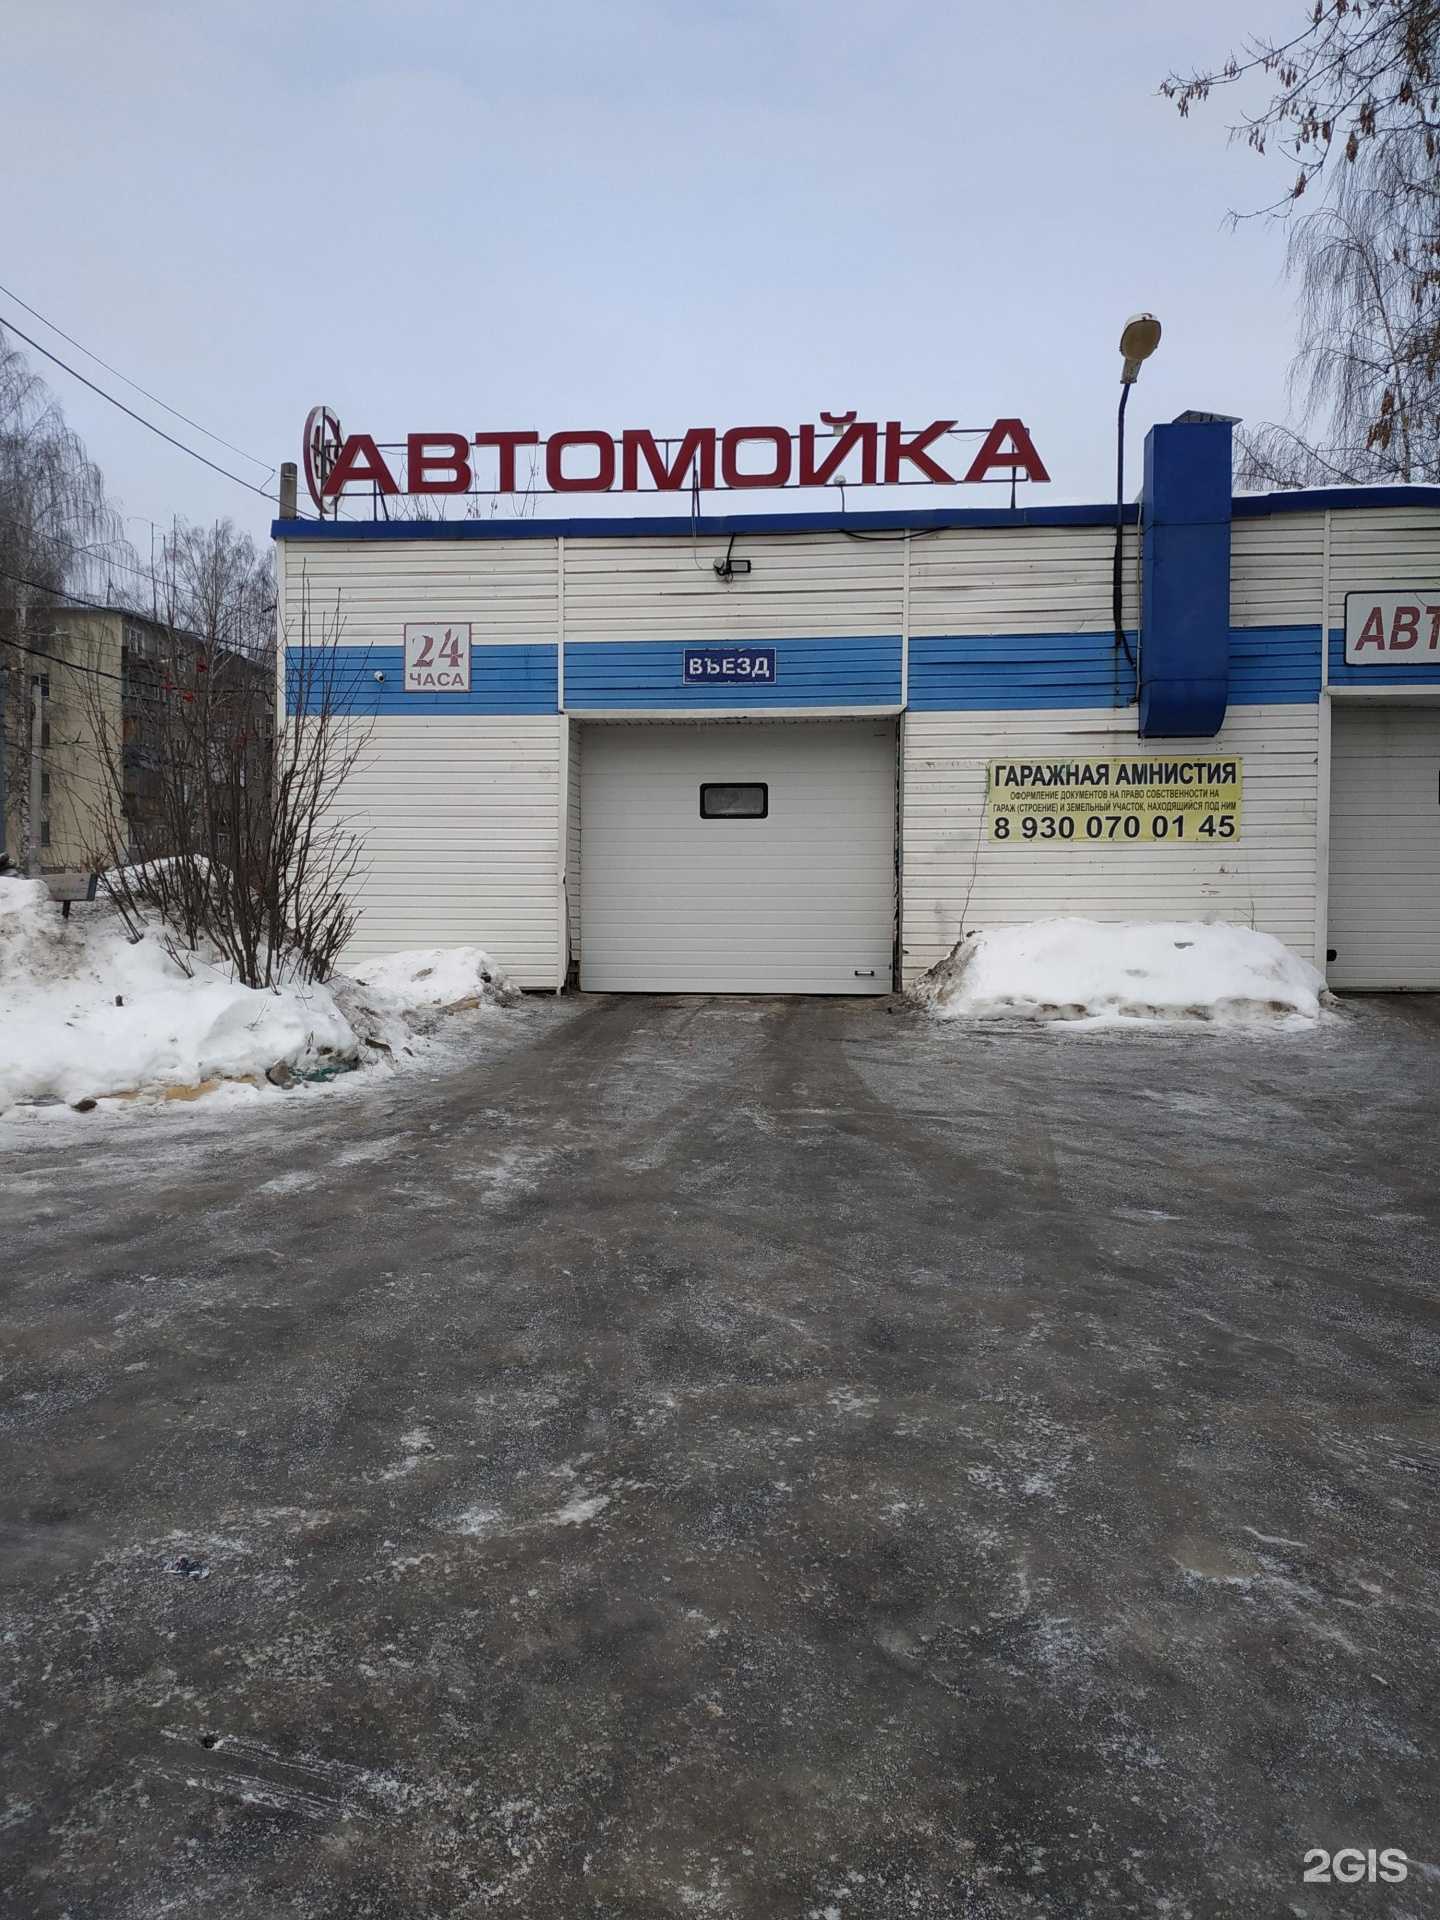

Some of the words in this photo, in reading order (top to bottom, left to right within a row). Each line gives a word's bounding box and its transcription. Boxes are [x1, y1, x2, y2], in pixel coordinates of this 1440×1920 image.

[323, 411, 1051, 496] АВТОМОЙКА
[411, 628, 464, 668] 24
[689, 657, 770, 678] ВЪЕЗД
[409, 672, 465, 687] ЧАСА
[995, 764, 1110, 786] ГАРАЖНАЯ
[1115, 762, 1237, 785] АМНИСТИЯ
[1010, 791, 1059, 801] ОФОРМЛЕНИЕ
[1060, 790, 1108, 800] ДОКУМЕНТОВ
[1109, 790, 1120, 799] НА
[1121, 789, 1145, 799] ПРАВО
[1146, 788, 1208, 799] СОБСТВЕННОСТИ
[1209, 788, 1220, 798] НА
[993, 804, 1016, 813] ГАРАЖ
[1017, 803, 1059, 814] (СТРОЕНИЕ)
[1060, 803, 1065, 812] И
[1066, 801, 1111, 812] ЗЕМЕЛЬНЫЙ
[1112, 802, 1146, 812] УЧАСТОК,
[1147, 801, 1203, 812] НАХОДЯЩИЙСЯ
[1204, 801, 1220, 812] ПОД
[1221, 801, 1237, 811] НИМ
[994, 817, 1010, 839] 8
[1021, 816, 1075, 839] 930
[1086, 815, 1141, 838] 070
[1151, 815, 1185, 838] 01
[1198, 814, 1236, 838] 45
